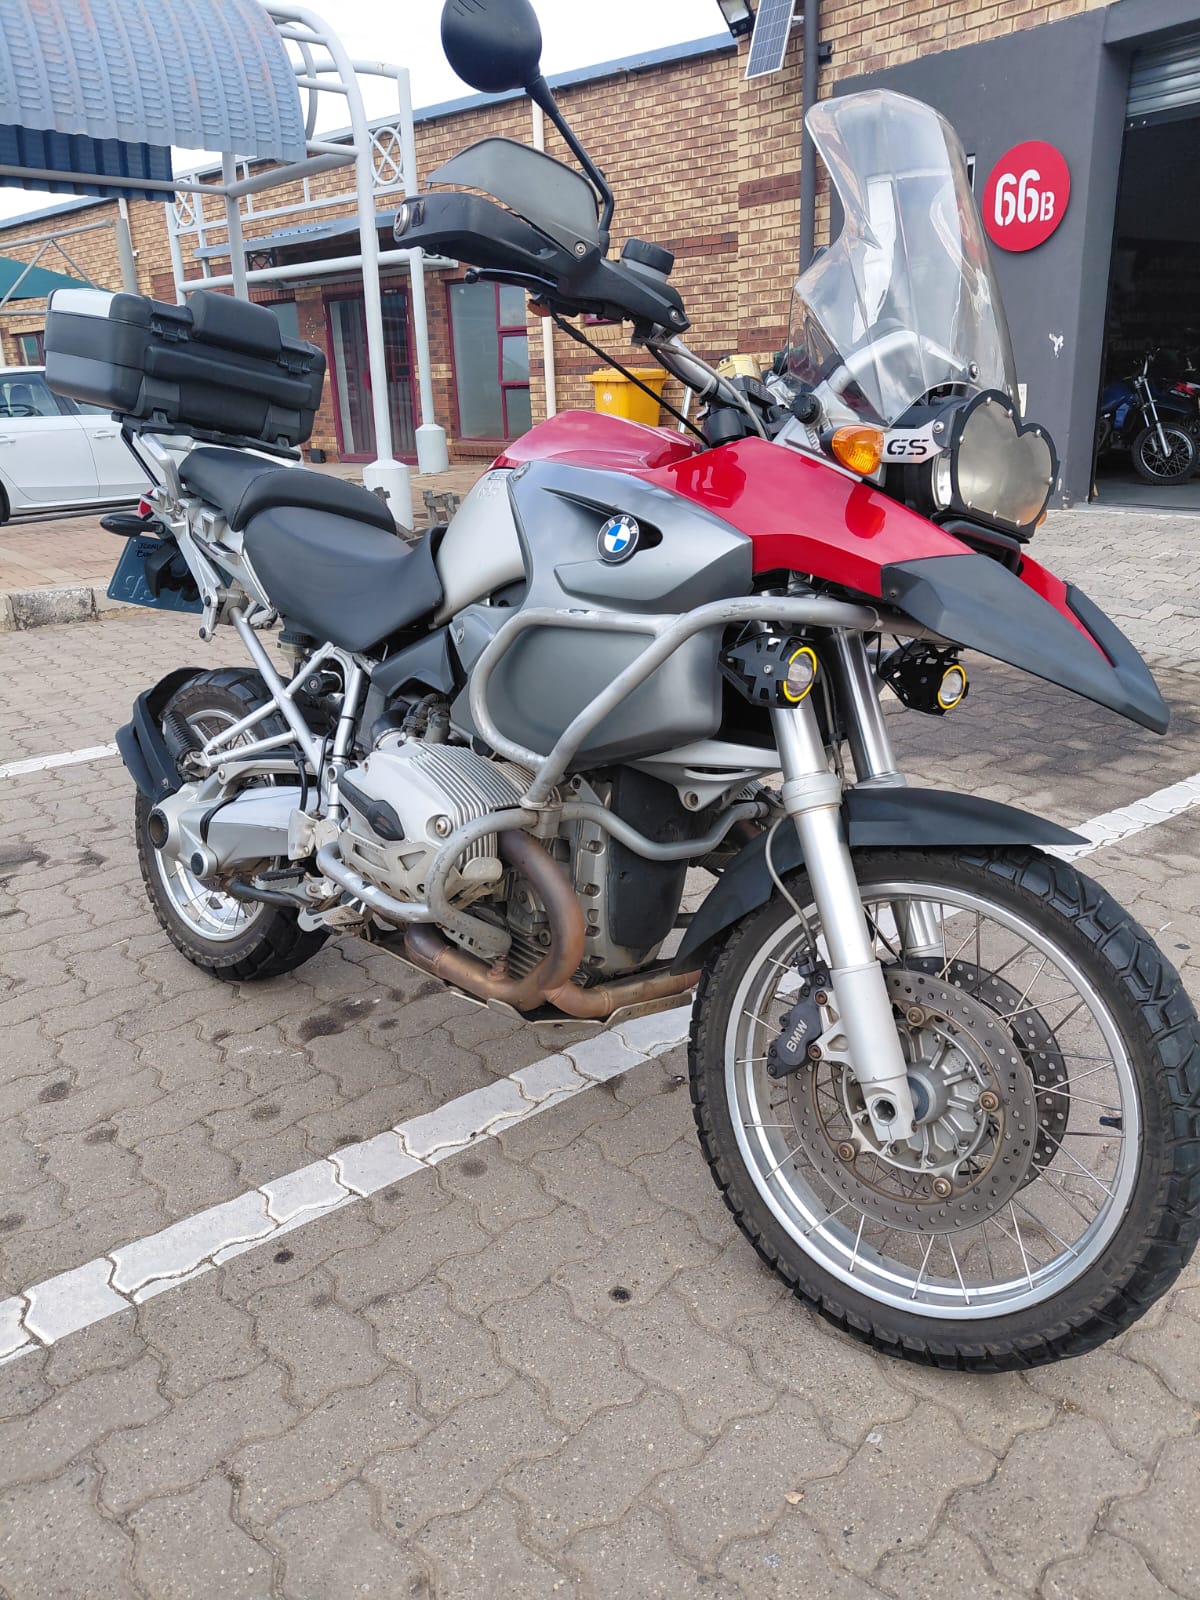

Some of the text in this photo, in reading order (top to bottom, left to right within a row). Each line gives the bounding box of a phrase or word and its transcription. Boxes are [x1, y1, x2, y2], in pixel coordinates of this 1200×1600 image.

[994, 169, 1055, 227] 66B
[886, 438, 930, 456] GS
[607, 516, 638, 535] BMW
[786, 1019, 808, 1053] BMW
